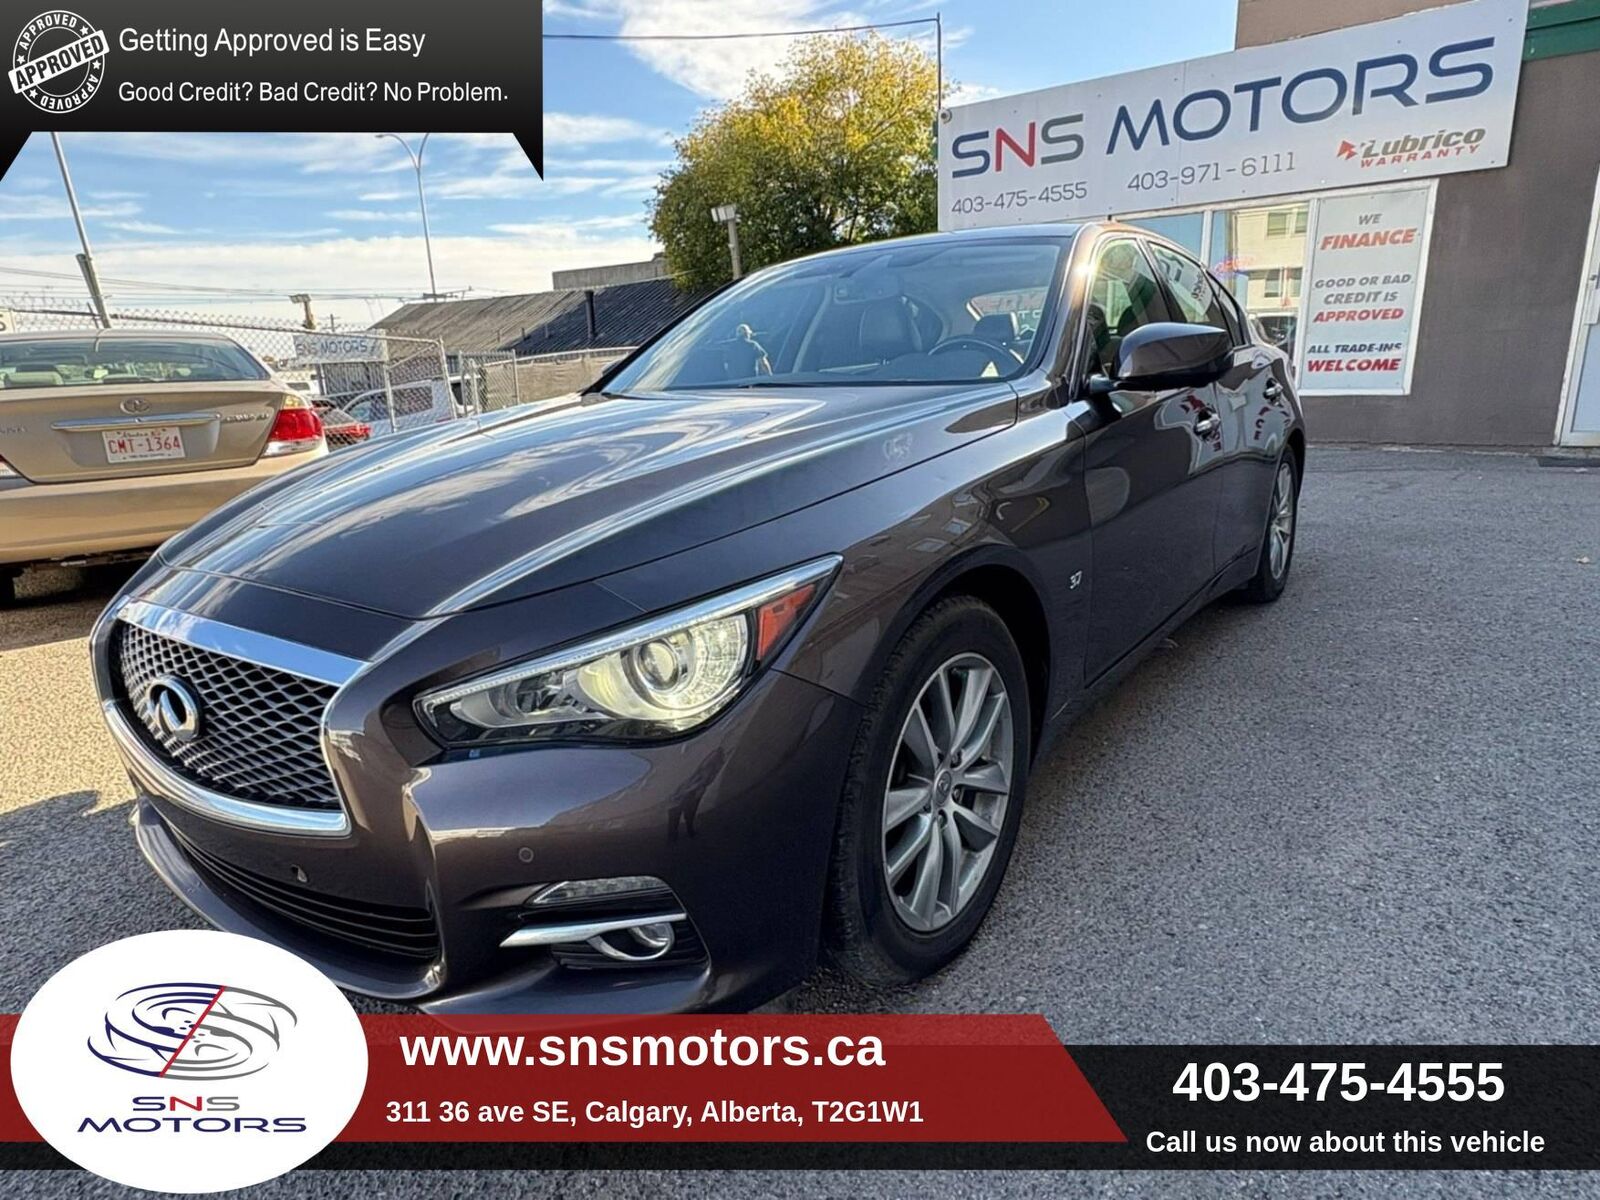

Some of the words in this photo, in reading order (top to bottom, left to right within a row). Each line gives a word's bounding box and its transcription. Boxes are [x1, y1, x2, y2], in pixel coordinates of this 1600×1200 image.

[951, 113, 1084, 178] SNS
[1106, 36, 1496, 155] MOTORS
[1361, 127, 1486, 159] Lubrico
[1360, 144, 1480, 168] WARRANTY
[1127, 152, 1297, 193] 403-971-6111
[951, 182, 1088, 215] 403-475-4555
[1358, 213, 1382, 225] WE
[1320, 228, 1417, 250] FINANCE
[1314, 278, 1355, 289] GOOD
[1358, 276, 1378, 286] OR
[1382, 274, 1411, 285] BAD
[1323, 291, 1382, 305] CREDIT
[1383, 291, 1398, 302] IS
[1312, 308, 1404, 323] APPROVED
[1307, 345, 1330, 354] ALL
[1334, 343, 1402, 354] TRADE-INS
[1307, 358, 1401, 372] WELCOME
[107, 435, 181, 454] CMT-1364
